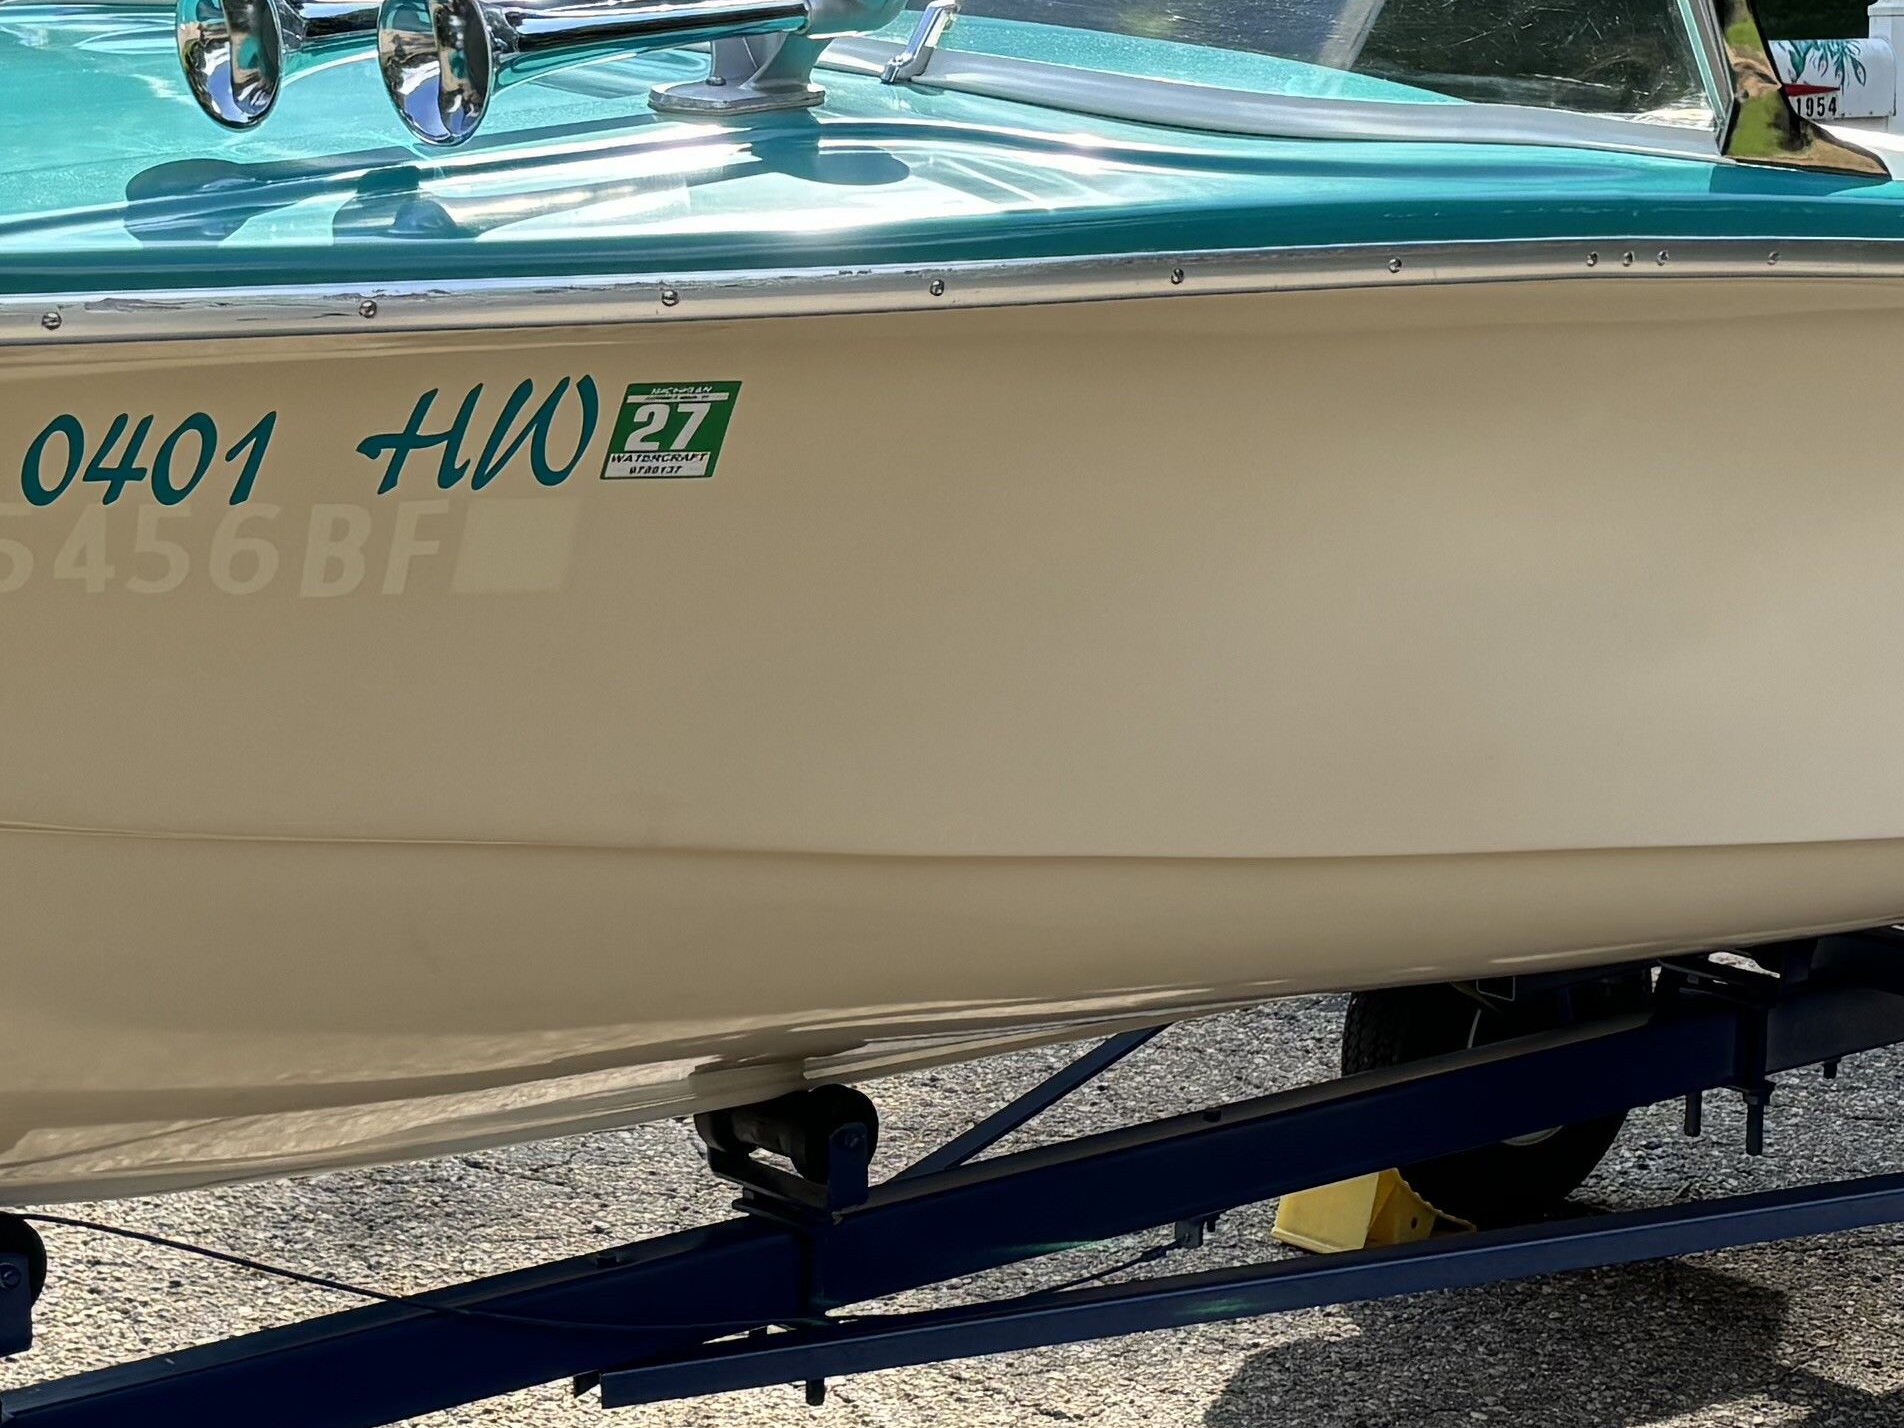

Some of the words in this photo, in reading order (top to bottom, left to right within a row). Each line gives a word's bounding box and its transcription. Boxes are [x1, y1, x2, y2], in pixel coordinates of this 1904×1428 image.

[1796, 96, 1837, 117] 1954
[21, 411, 277, 506] 0401
[357, 375, 599, 493] HW
[624, 403, 711, 451] 27
